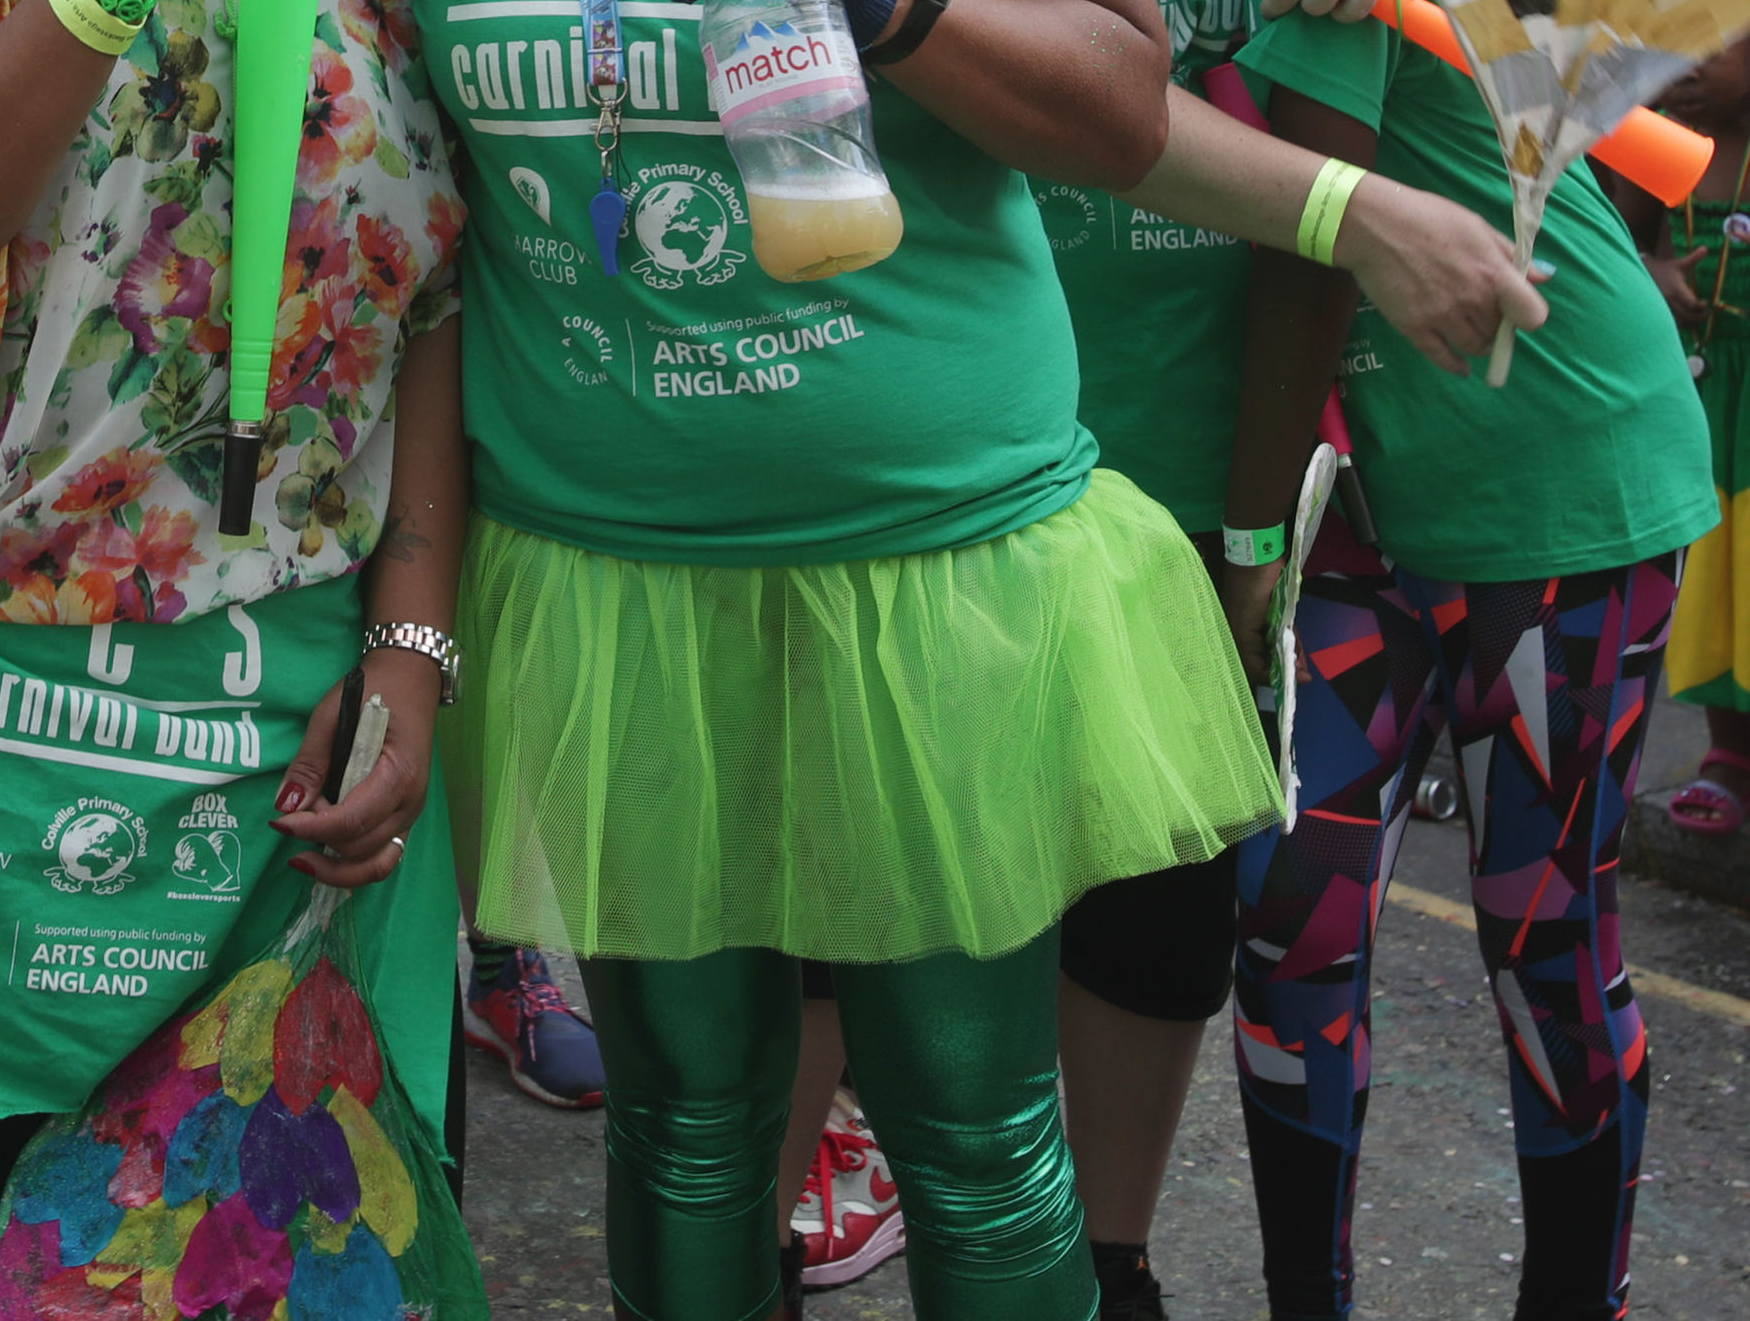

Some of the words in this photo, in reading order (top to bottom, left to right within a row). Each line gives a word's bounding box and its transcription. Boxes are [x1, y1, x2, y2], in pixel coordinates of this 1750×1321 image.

[451, 26, 680, 110] carnial
[725, 35, 832, 94] match
[637, 163, 707, 184] Primary
[707, 171, 749, 225] School
[1051, 185, 1097, 224] COUNCIL
[530, 259, 578, 285] CLUB
[709, 318, 744, 334] using
[745, 311, 785, 328] public
[786, 300, 832, 320] funding
[833, 296, 850, 309] by
[563, 315, 613, 363] COUNCIL
[653, 340, 728, 367] ARTS
[736, 314, 865, 363] COUNCIL
[564, 358, 608, 386] ENGLAN
[654, 363, 801, 398] ENGLAND
[178, 812, 238, 828] CLEVER
[192, 792, 228, 813] BOX
[41, 806, 76, 850] Colville
[77, 796, 133, 821] Primary
[131, 816, 149, 858] School
[167, 891, 241, 902] #boxcleversports
[35, 923, 89, 938] Supported
[90, 928, 117, 941] using
[118, 928, 150, 942] public
[151, 929, 192, 944] funding
[193, 930, 207, 945] by
[31, 943, 96, 967] ARTS
[103, 946, 210, 972] COUNCIL
[26, 968, 149, 998] ENGLAND
